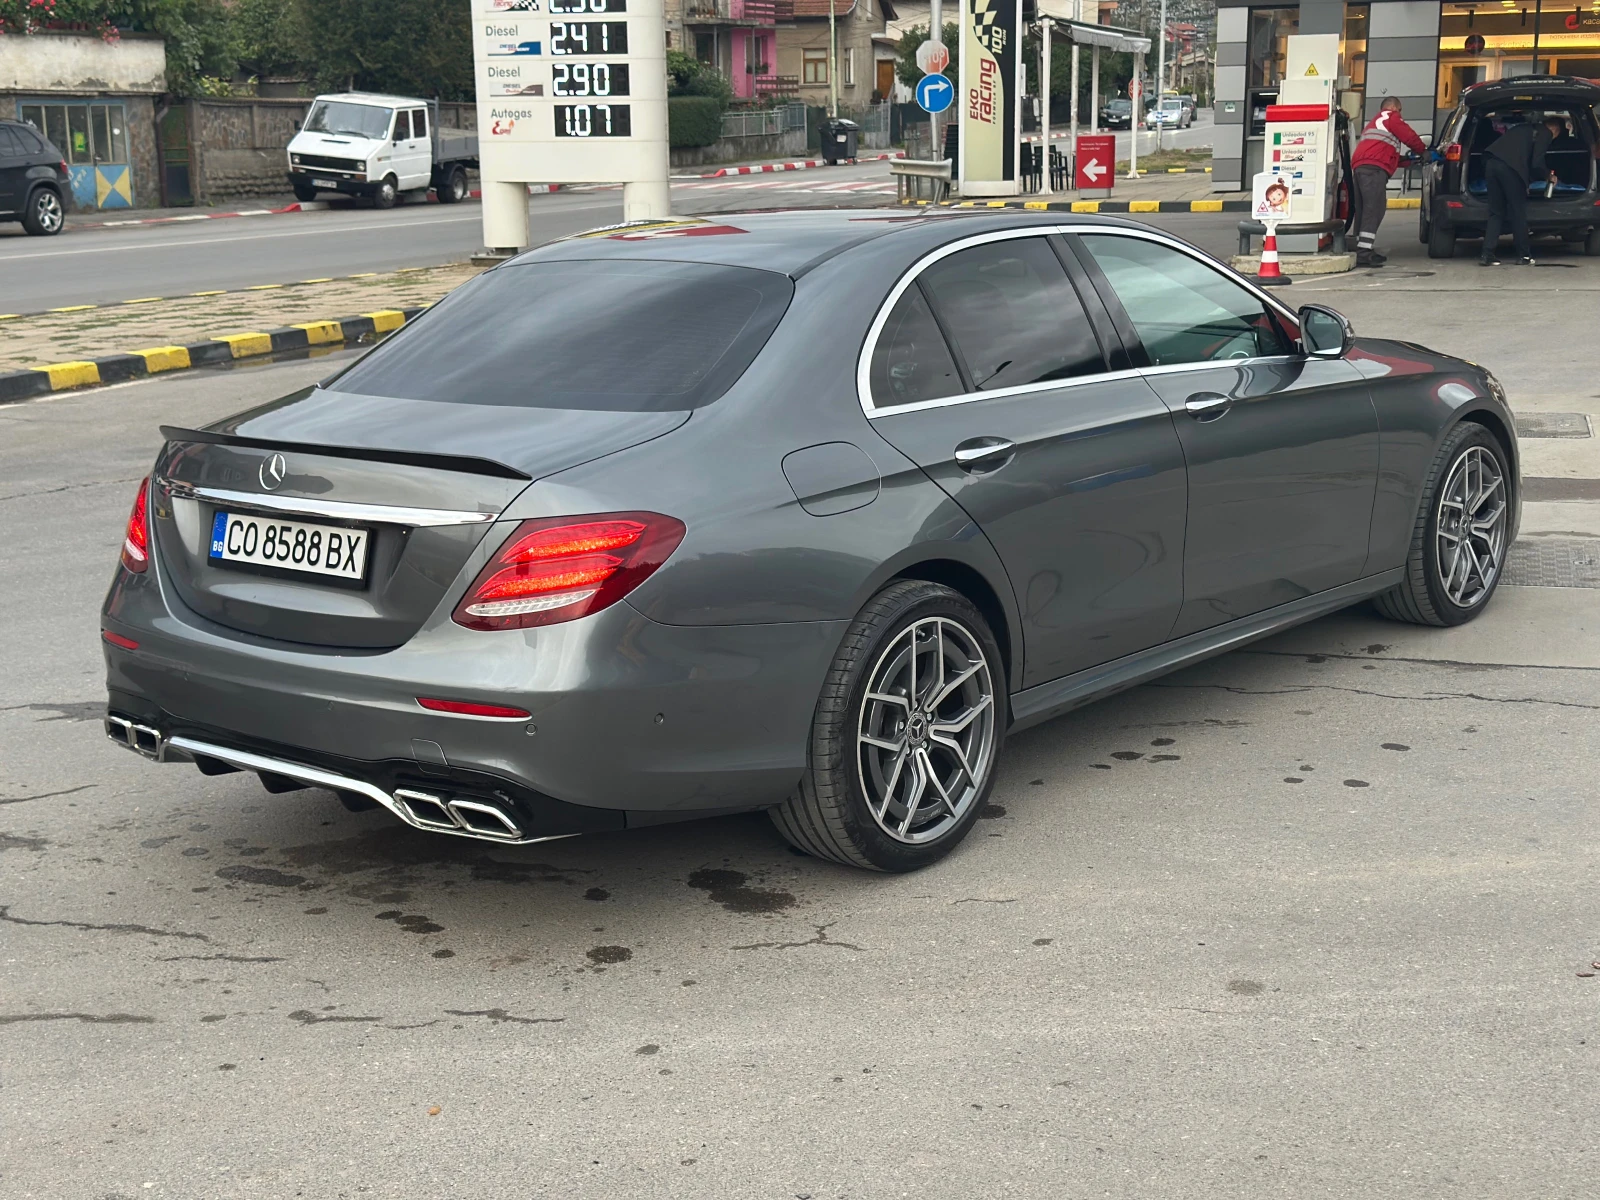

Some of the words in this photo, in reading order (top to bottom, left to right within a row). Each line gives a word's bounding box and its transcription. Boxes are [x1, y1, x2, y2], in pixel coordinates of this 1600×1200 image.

[485, 25, 518, 37] Diesel
[551, 22, 608, 54] 2.41
[992, 26, 1003, 54] 100
[488, 67, 521, 77] Diesel
[553, 63, 610, 96] 2.90
[969, 88, 979, 121] EKO
[980, 57, 996, 124] racing
[491, 108, 532, 120] Autogas
[565, 105, 612, 136] 1.07
[212, 540, 224, 552] BG
[227, 519, 259, 557] CO
[262, 524, 322, 566] 8588
[325, 532, 362, 573] BX
